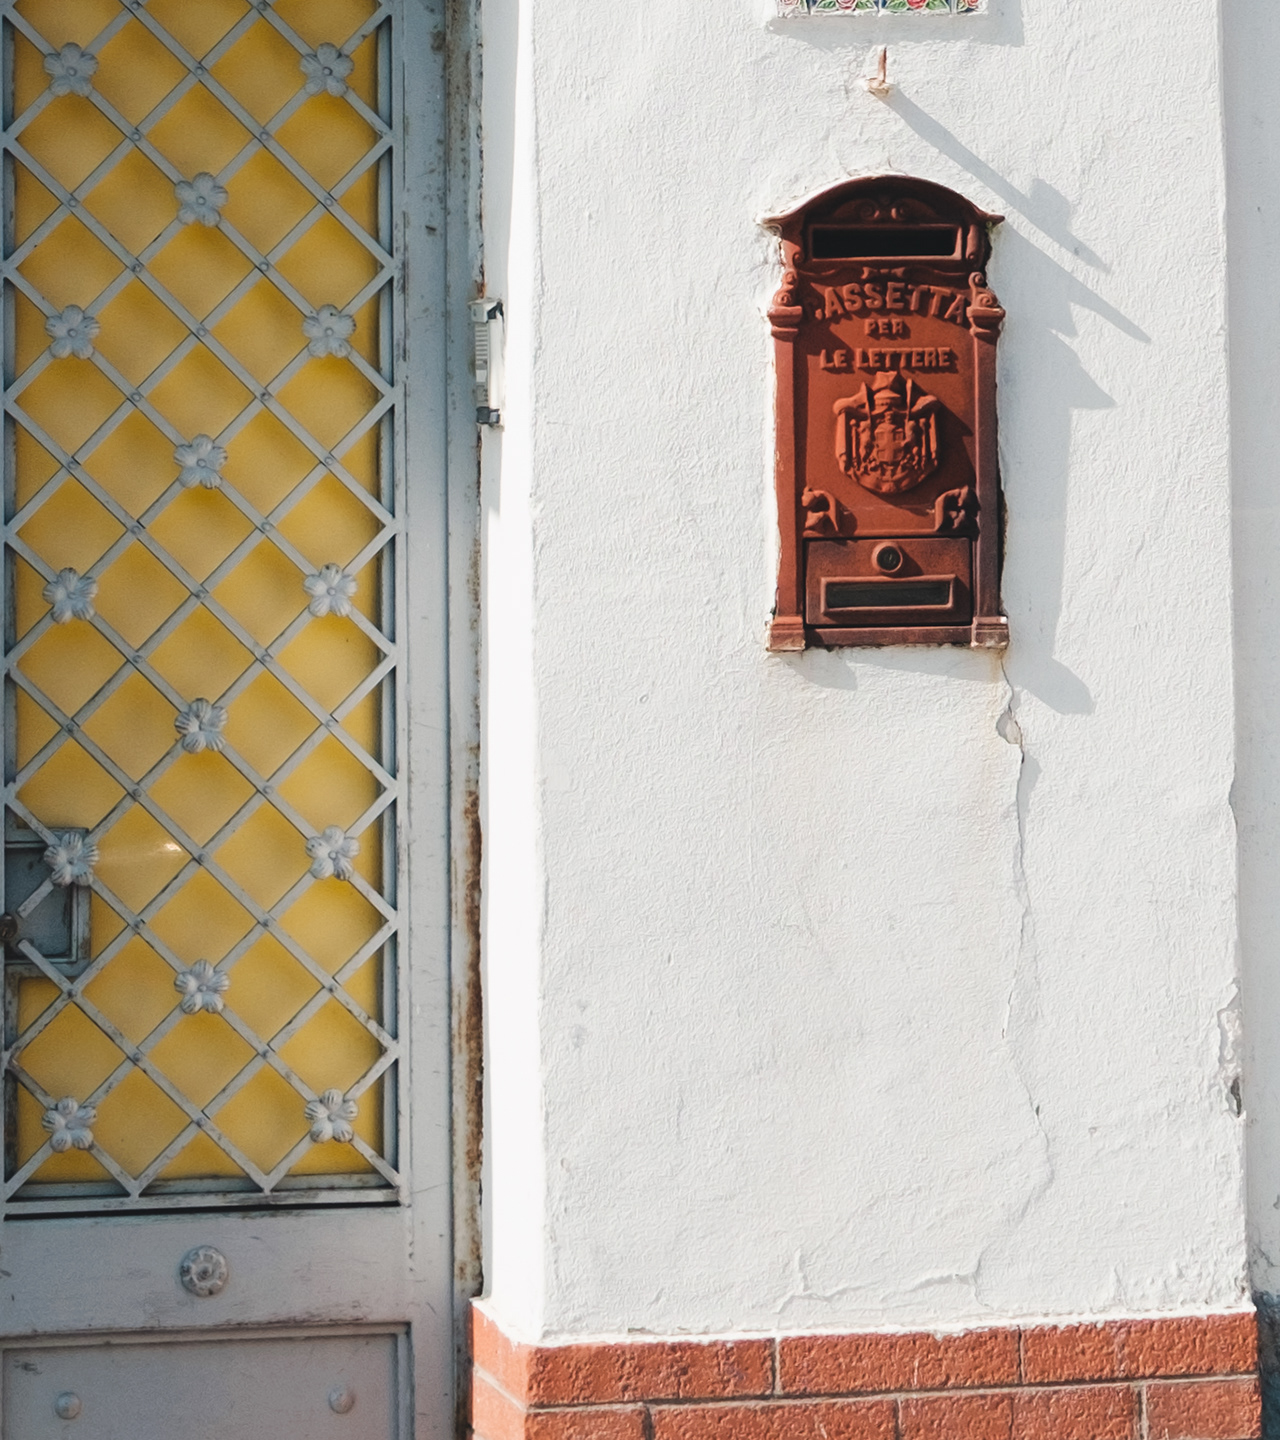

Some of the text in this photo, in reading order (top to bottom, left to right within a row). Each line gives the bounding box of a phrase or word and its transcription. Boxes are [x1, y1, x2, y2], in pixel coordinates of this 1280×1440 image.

[813, 281, 966, 324] ASSETTA
[864, 319, 904, 336] PER
[821, 347, 952, 370] LE LETTERE
